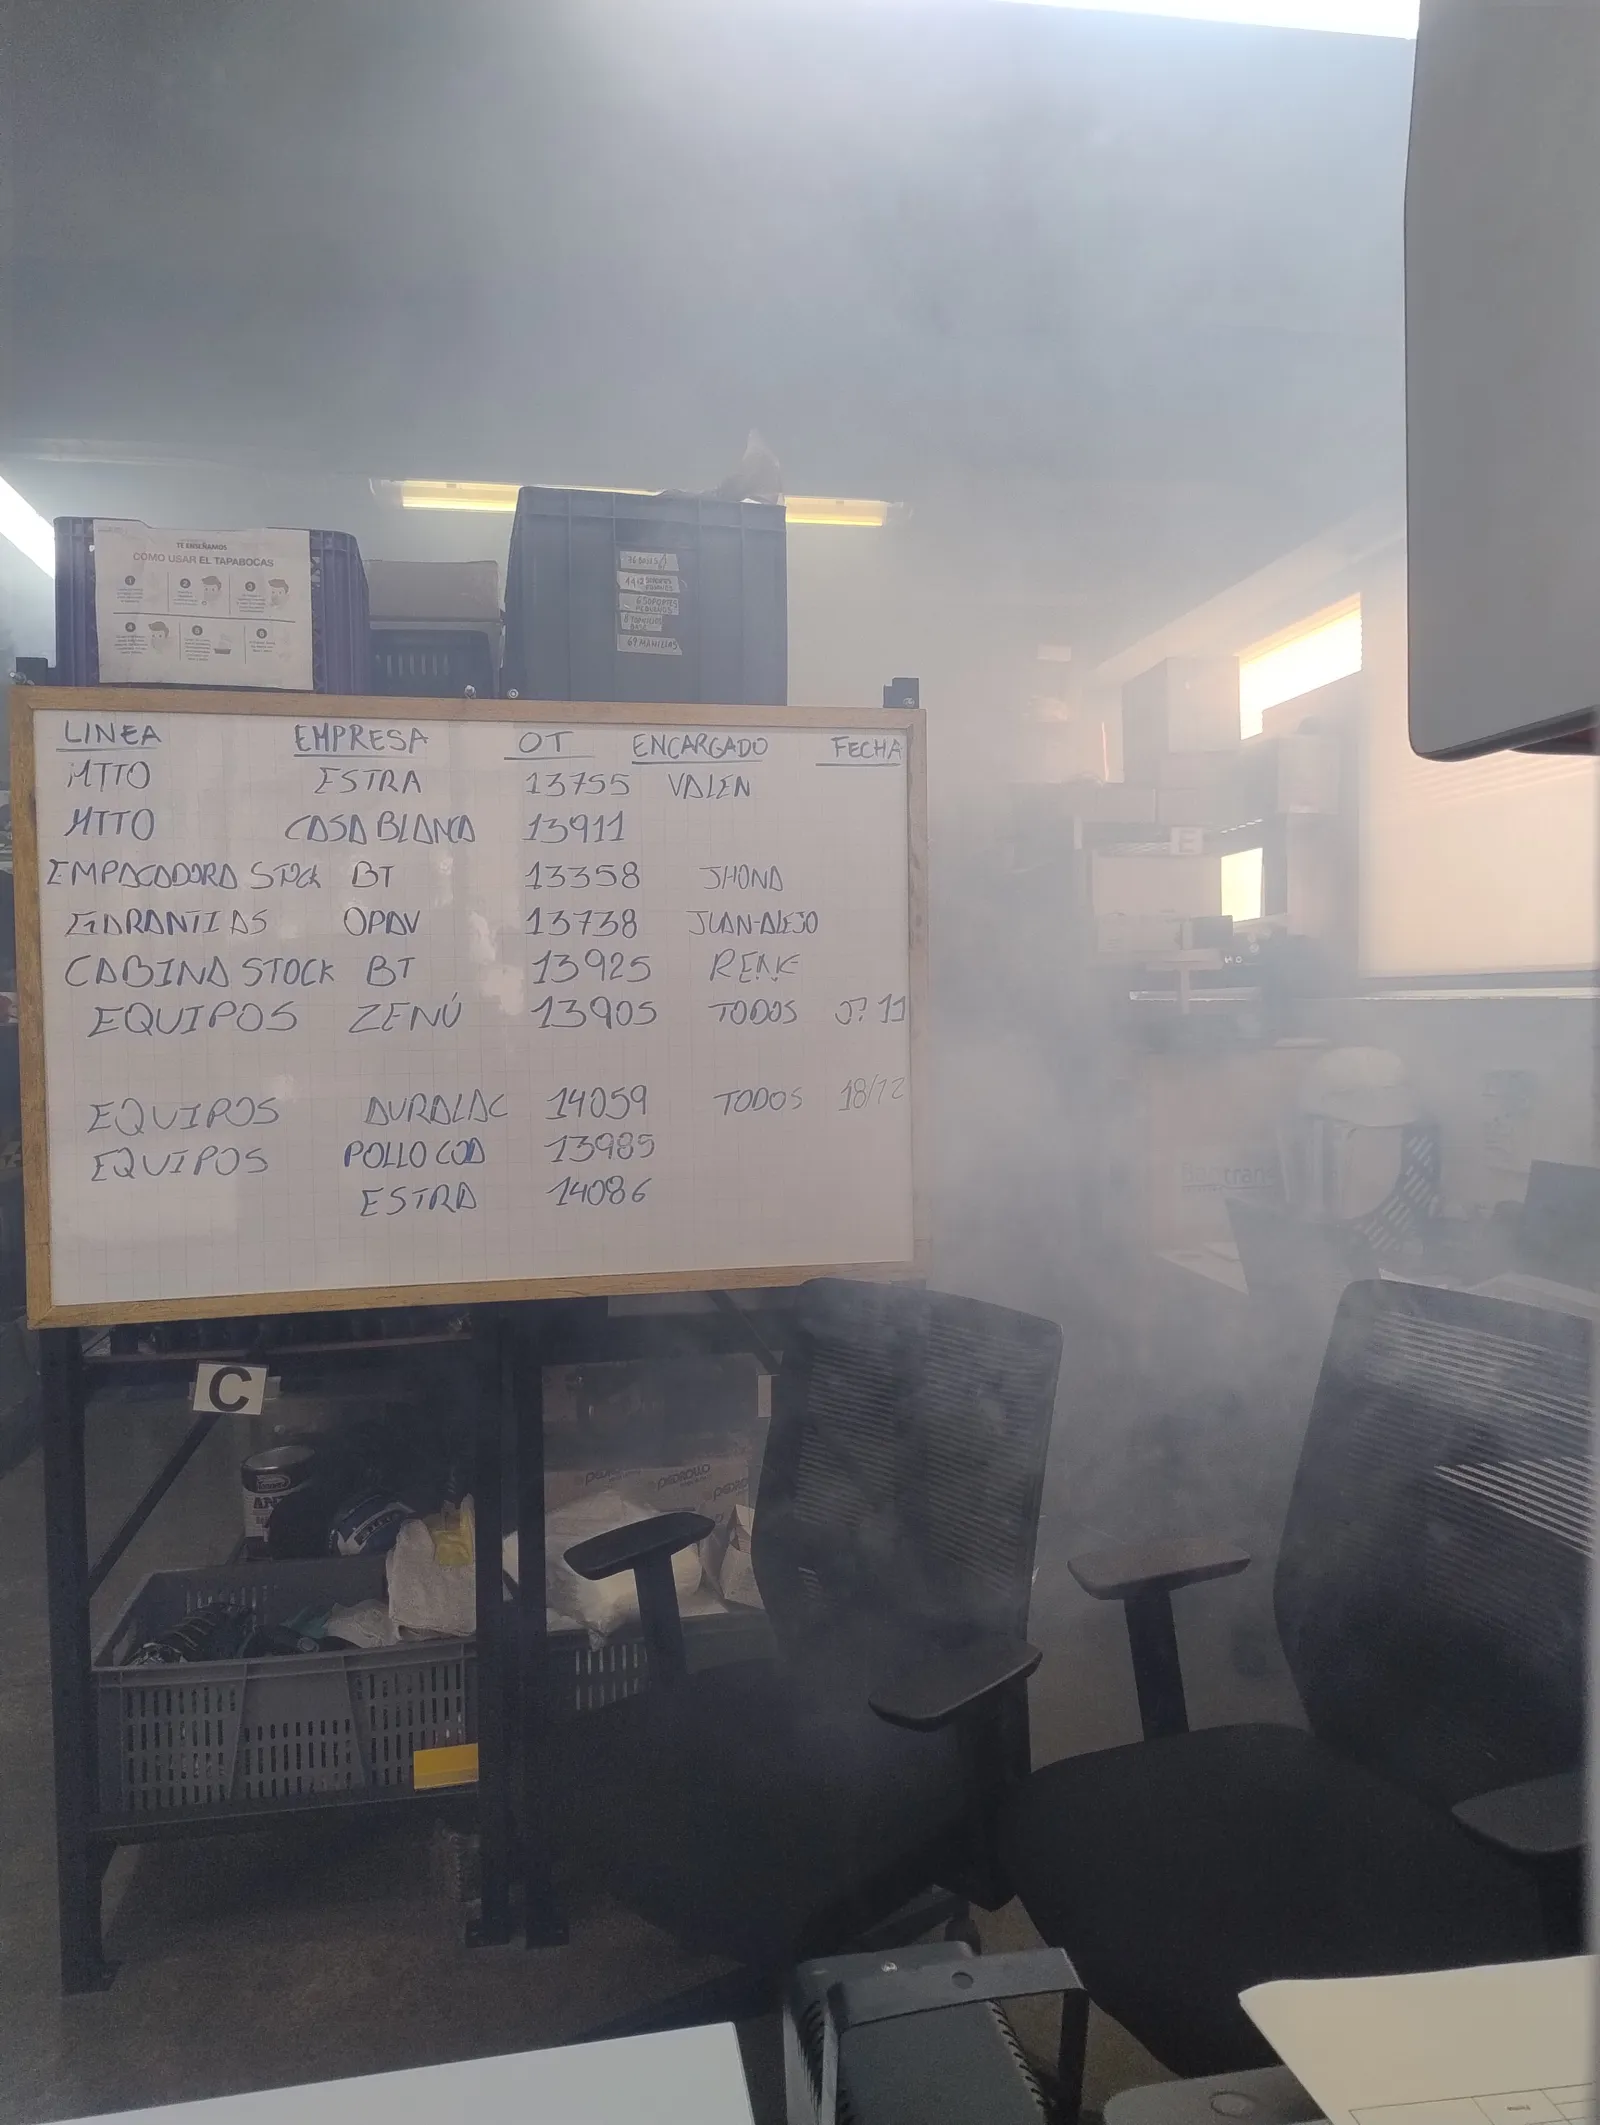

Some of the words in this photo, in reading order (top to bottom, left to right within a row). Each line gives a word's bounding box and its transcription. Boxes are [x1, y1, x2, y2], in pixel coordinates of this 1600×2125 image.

[168, 554, 197, 564] USAR
[199, 556, 212, 565] EL
[214, 557, 274, 568] TAPABOCAS
[176, 541, 185, 549] TE
[64, 721, 163, 746] LINEA
[293, 722, 430, 754] EMPRESA
[518, 730, 574, 754] OT
[632, 732, 769, 760] ENCARGADO
[830, 736, 902, 760] FECHA
[66, 758, 151, 793] MTTO
[313, 766, 422, 795] ESTRA
[525, 771, 630, 797] 13755
[667, 772, 751, 800] VALEN
[63, 805, 155, 842] MTTO
[522, 810, 625, 844] 13911
[46, 858, 238, 890] EMPACADORA
[351, 860, 395, 889] BT
[524, 860, 641, 891] 13358
[524, 906, 638, 939] 13738
[64, 954, 230, 989] CABINA
[241, 957, 335, 988] STOCK
[366, 955, 416, 987] BT
[531, 948, 651, 985] 13925
[86, 1000, 298, 1038] EQUIPOS
[348, 991, 462, 1034] ZENÚ
[530, 995, 658, 1030] 13905
[707, 998, 798, 1026] TODOS
[86, 1096, 280, 1137] EQUIPOS
[545, 1084, 647, 1121] 14059
[713, 1086, 803, 1116] TODOS
[543, 1131, 655, 1163] 13985
[90, 1145, 269, 1182] EQUIPOS
[359, 1181, 477, 1217] ESTRA
[545, 1175, 653, 1207] 14086
[208, 1365, 253, 1413] C
